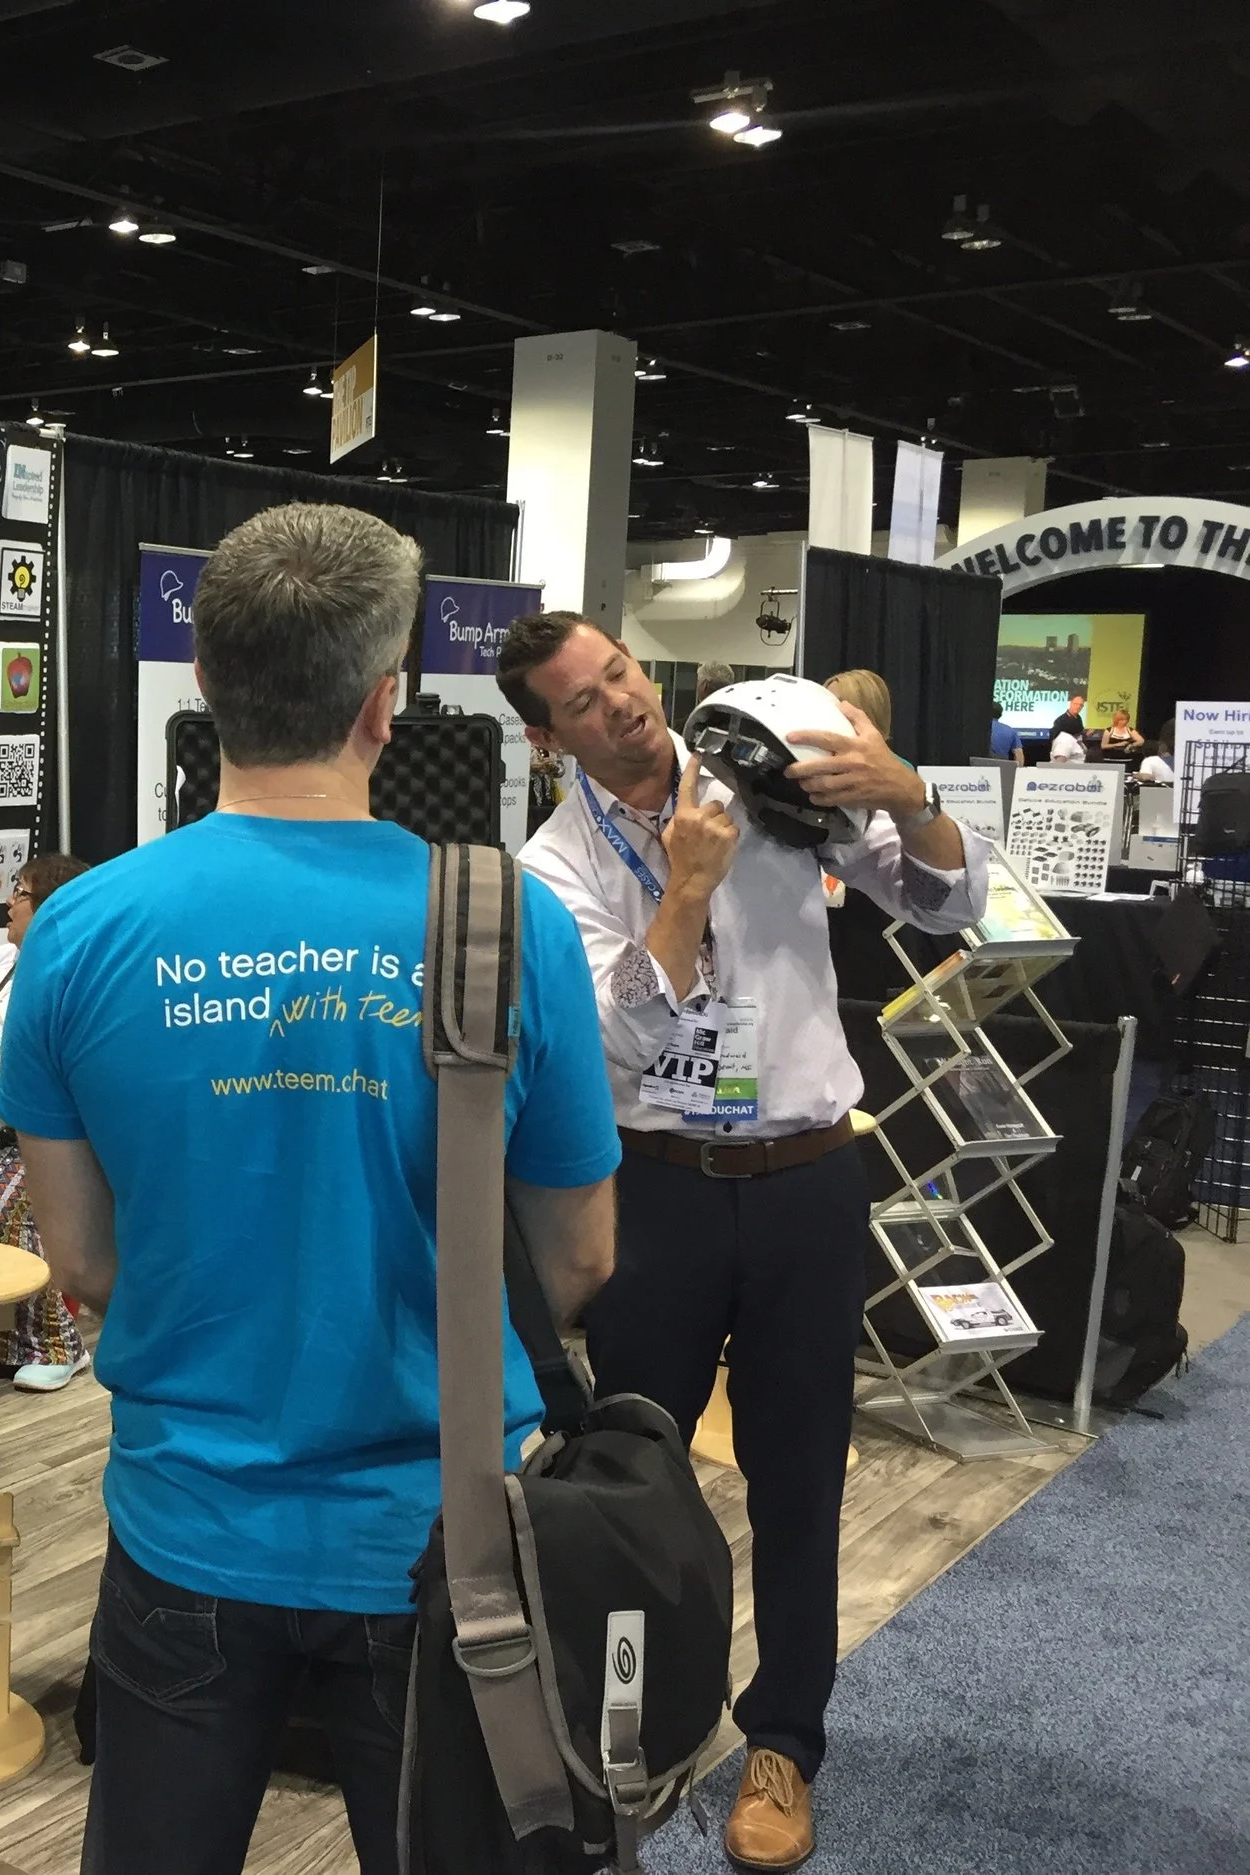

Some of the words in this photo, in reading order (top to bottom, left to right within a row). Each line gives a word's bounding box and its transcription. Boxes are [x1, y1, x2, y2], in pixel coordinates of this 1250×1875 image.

[1138, 515, 1188, 550] TO
[1199, 519, 1250, 564] TH
[172, 599, 195, 623] Bu
[449, 620, 483, 650] Bump
[483, 622, 511, 643] Arm
[479, 646, 495, 658] Tech
[994, 679, 1029, 690] ATION
[993, 690, 1069, 702] SFORMATION
[1005, 701, 1035, 712] HERE
[1184, 709, 1219, 721] Now
[1225, 710, 1250, 721] Hir
[503, 732, 526, 746] packs
[939, 779, 990, 792] ezrobot
[1038, 776, 1104, 793] ezrobot
[598, 818, 628, 853] MAX
[156, 955, 206, 986] No
[218, 941, 359, 978] teacher
[372, 945, 399, 979] is
[411, 962, 425, 987] a
[164, 986, 270, 1028] island
[282, 985, 348, 1024] with
[652, 1053, 714, 1084] VIP
[210, 1068, 388, 1101] www.teem.chat
[711, 1105, 754, 1115] DUCHAT
